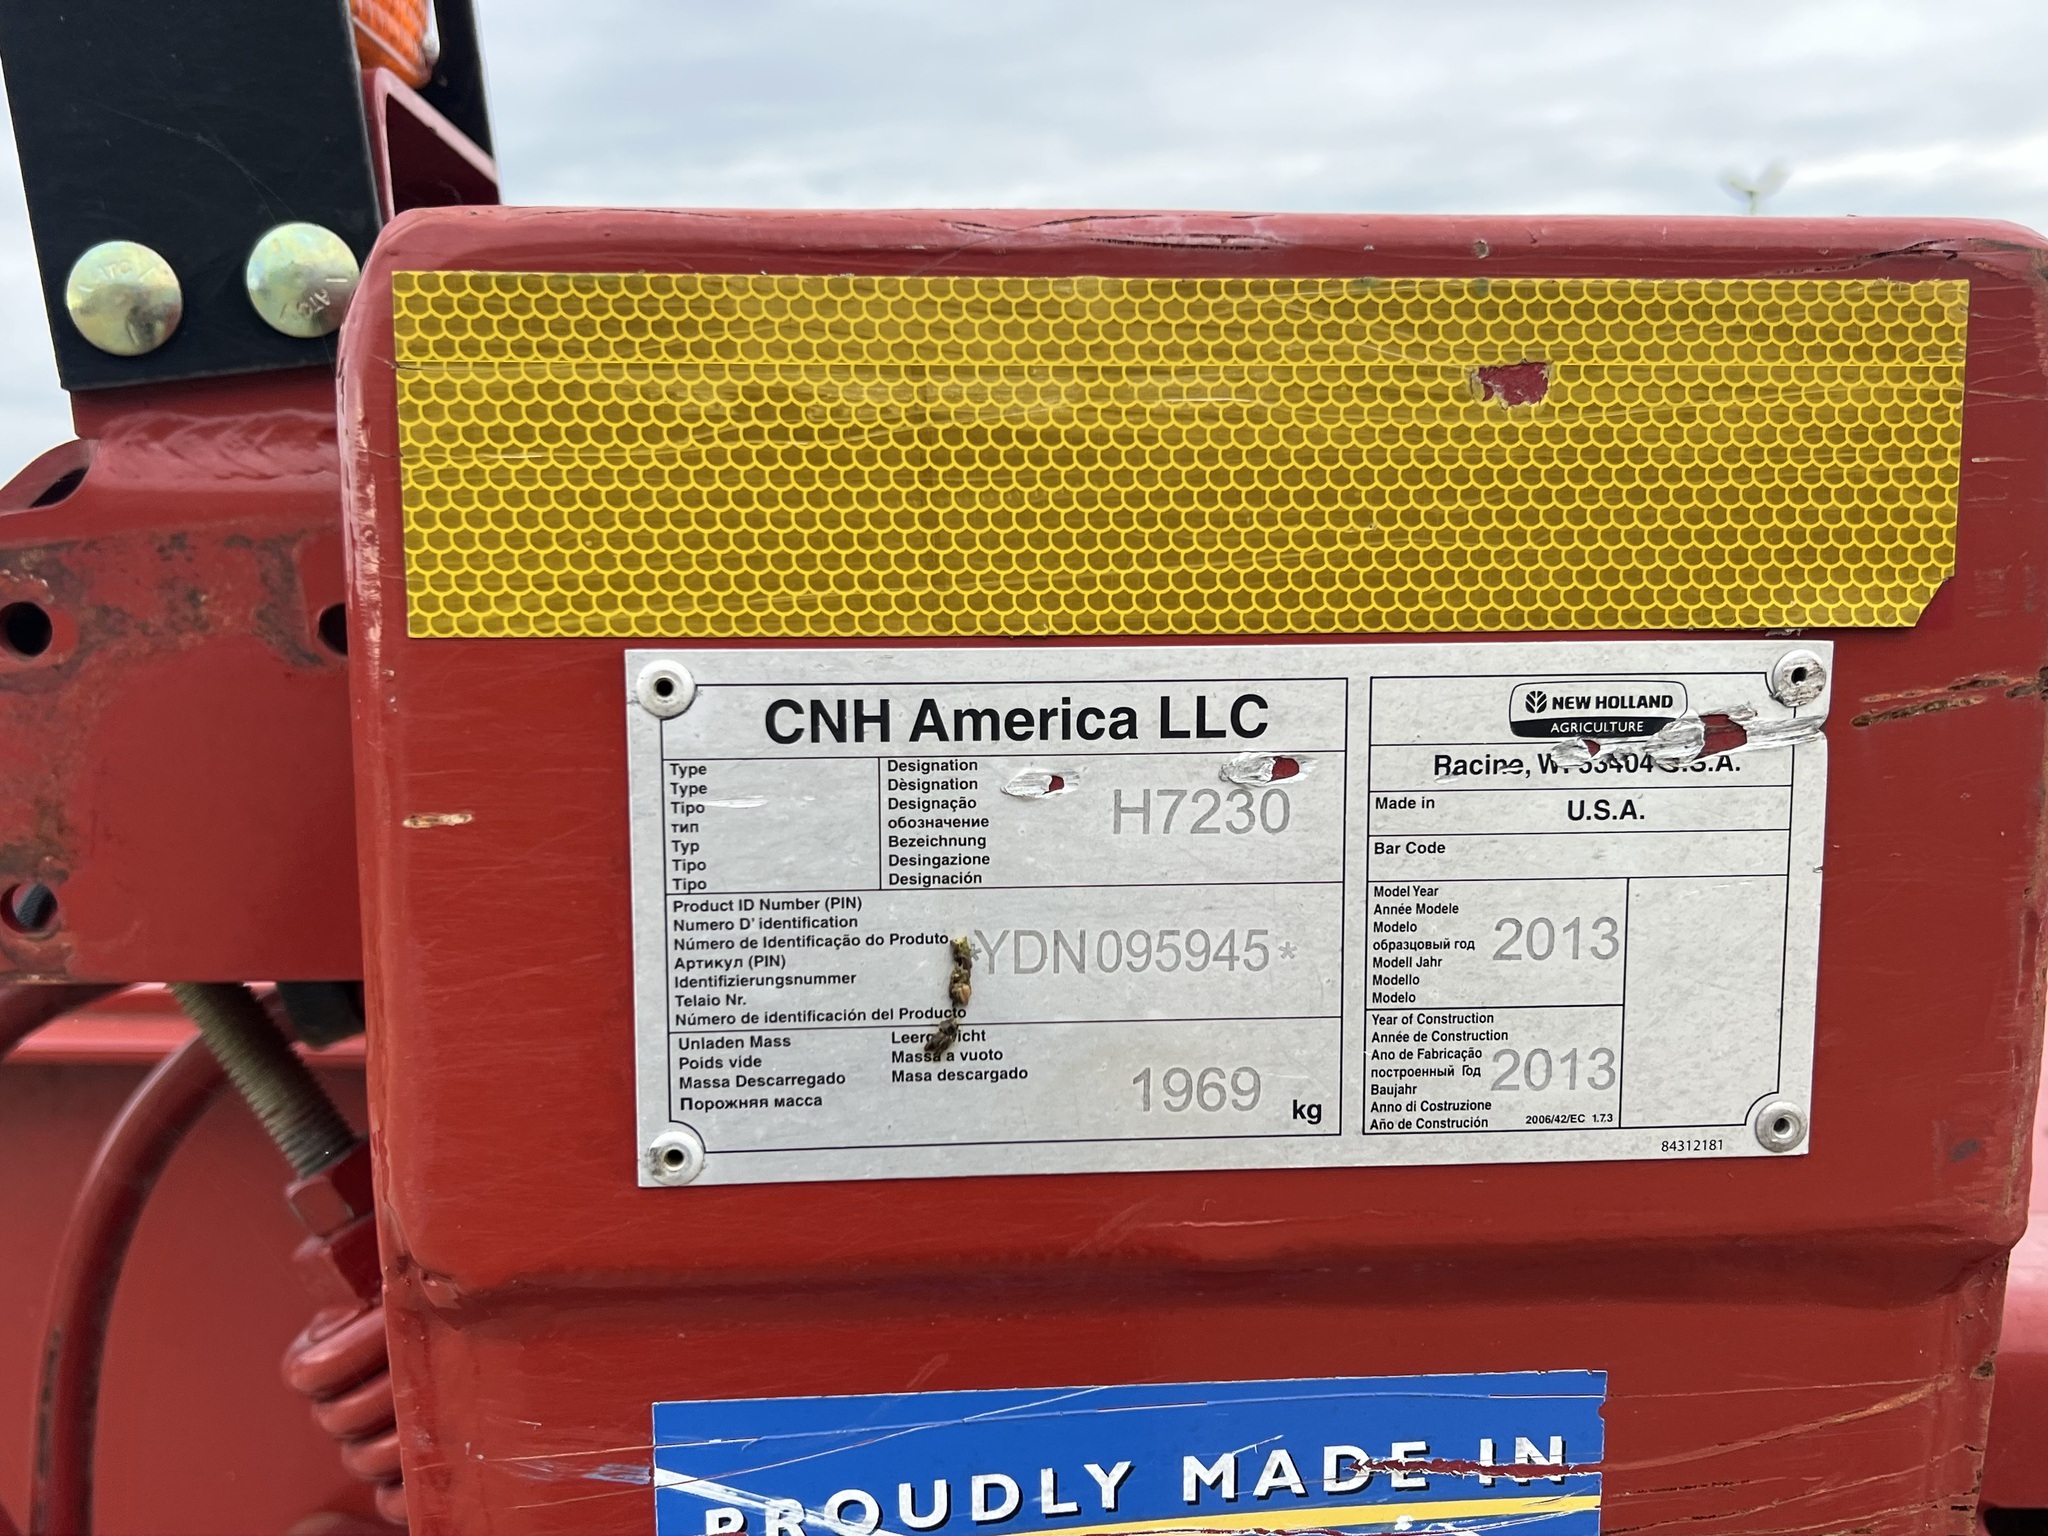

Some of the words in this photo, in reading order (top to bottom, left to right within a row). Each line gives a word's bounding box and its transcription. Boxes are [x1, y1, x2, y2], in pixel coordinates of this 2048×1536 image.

[1551, 695, 1592, 710] NEW
[1595, 694, 1674, 710] HOLLAND
[764, 698, 891, 745] CNH
[908, 696, 1139, 743] America
[1160, 693, 1269, 740] LLC
[1550, 721, 1643, 733] AGRICULTURE
[669, 762, 707, 778] Type
[887, 758, 978, 775] Designation
[1434, 753, 1531, 779] Racine,
[669, 782, 708, 797] Type
[887, 777, 978, 794] Dèsignation
[670, 801, 705, 817] Tipo
[888, 796, 977, 813] Designação
[1375, 796, 1417, 810] Made
[1421, 796, 1435, 809] in
[1567, 798, 1645, 822] U.S.A.
[1112, 788, 1291, 835] H7230
[670, 823, 699, 833] тип
[887, 816, 990, 829] обозначение
[671, 839, 700, 855] Typ
[888, 834, 987, 850] Bezeichnung
[1374, 841, 1401, 855] Bar
[1405, 841, 1446, 855] Code
[671, 858, 707, 874] Tipo
[888, 853, 991, 870] Desingazione
[671, 877, 707, 893] Tipo
[888, 871, 982, 888] Designación
[1373, 885, 1411, 898] Model
[1412, 885, 1439, 897] Year
[673, 899, 734, 913] Product
[738, 898, 755, 912] ID
[759, 898, 821, 911] Number
[824, 896, 863, 913] (PIN)
[1373, 902, 1413, 915] Année
[1415, 902, 1459, 915] Modele
[673, 919, 735, 932] Numero
[758, 916, 858, 930] identification
[1373, 921, 1418, 933] Modelo
[674, 937, 735, 951] Número
[739, 936, 759, 950] de
[762, 933, 861, 951] Identificação
[865, 934, 885, 947] do
[889, 932, 952, 948] Produto
[1372, 937, 1451, 954] образцовый
[1454, 940, 1476, 951] год
[1492, 916, 1619, 960] 2013
[674, 957, 744, 973] Артикул
[748, 954, 786, 971] (PIN)
[1372, 956, 1413, 969] Modell
[1415, 956, 1443, 968] Jahr
[674, 974, 857, 989] Identifizierungsnummer
[1372, 974, 1420, 986] Modello
[674, 993, 721, 1008] Telaio
[725, 993, 747, 1006] Nr.
[1372, 991, 1416, 1004] Modelo
[675, 1012, 736, 1026] Número
[740, 1011, 760, 1025] de
[764, 1008, 867, 1024] identificación
[871, 1007, 894, 1021] del
[899, 1006, 967, 1020] Producto
[1371, 1013, 1399, 1026] Year
[1401, 1013, 1414, 1025] of
[1416, 1012, 1494, 1025] Construction
[678, 1036, 745, 1051] Unladen
[749, 1035, 792, 1049] Mass
[891, 1030, 986, 1044] Leericht
[1371, 1030, 1410, 1044] Année
[1412, 1030, 1428, 1043] de
[1431, 1029, 1509, 1042] Construction
[678, 1056, 724, 1070] Poids
[728, 1054, 763, 1069] vide
[891, 1051, 941, 1064] Massa
[945, 1051, 955, 1062] a
[959, 1048, 1004, 1062] vuoto
[1370, 1048, 1396, 1061] Ano
[1398, 1048, 1414, 1060] de
[1417, 1046, 1483, 1063] Fabricação
[891, 1069, 932, 1083] Masa
[936, 1066, 1029, 1084] descargado
[1370, 1064, 1455, 1081] построенный
[1462, 1064, 1482, 1078] Год
[1490, 1047, 1616, 1092] 2013
[679, 1076, 730, 1090] Massa
[735, 1071, 846, 1089] Descarregado
[1132, 1066, 1262, 1113] 1969
[1292, 1099, 1322, 1125] kg
[1370, 1083, 1418, 1098] Baujahr
[680, 1097, 769, 1114] Порожняя
[774, 1096, 823, 1108] масса
[1370, 1101, 1403, 1113] Anno
[1405, 1100, 1417, 1113] di
[1420, 1099, 1492, 1112] Costruzione
[1369, 1118, 1395, 1131] Año
[1397, 1118, 1413, 1130] de
[1415, 1115, 1489, 1130] Construción
[1525, 1113, 1586, 1125] 2006/42/EC
[1661, 1139, 1723, 1153] 84312181
[1183, 1440, 1430, 1504] MADE
[1480, 1435, 1567, 1485] IN
